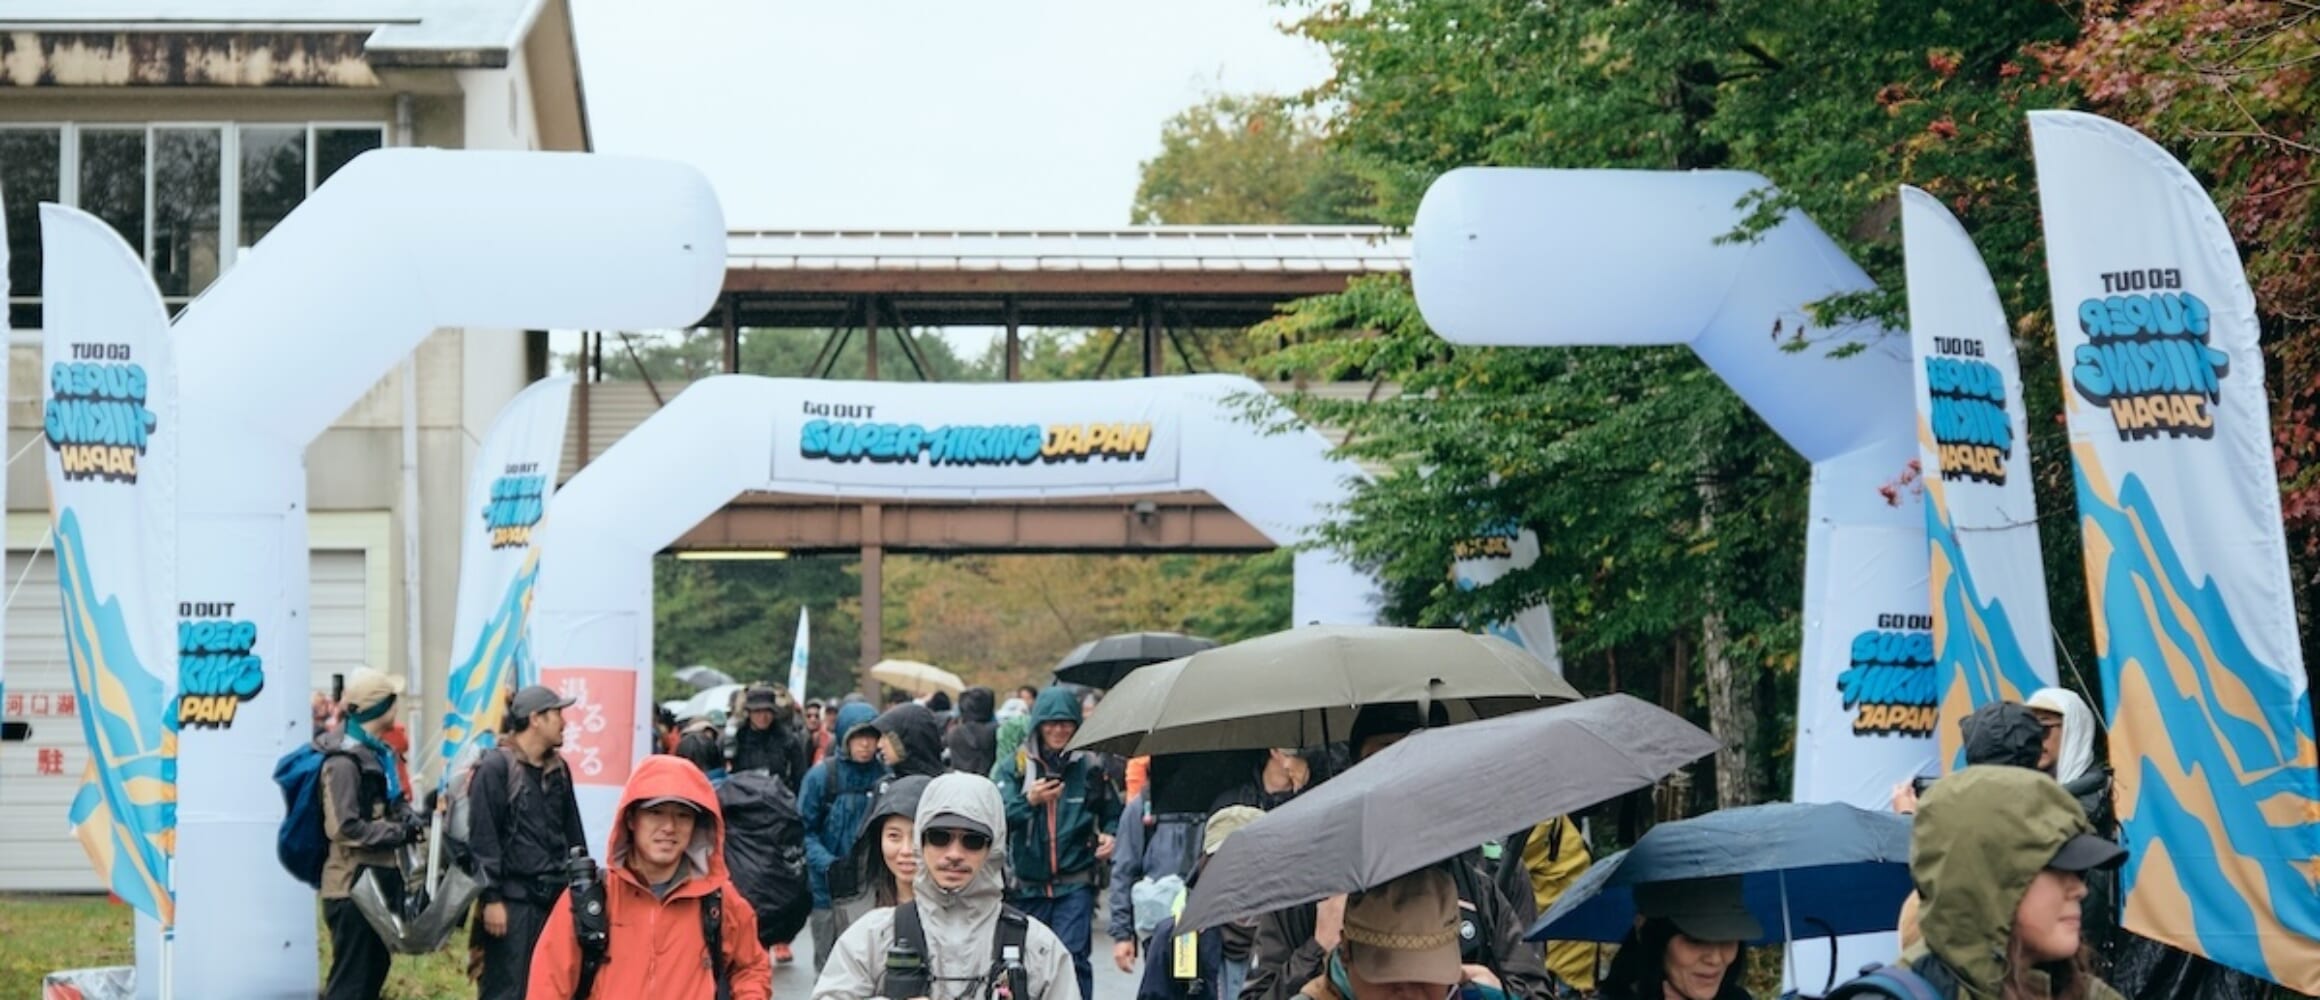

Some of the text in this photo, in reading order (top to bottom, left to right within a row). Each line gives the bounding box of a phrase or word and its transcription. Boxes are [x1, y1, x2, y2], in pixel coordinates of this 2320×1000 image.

[803, 401, 875, 419] GO OUT
[1041, 423, 1151, 464] JAPAN
[179, 602, 235, 617] O OUT
[1878, 614, 1933, 629] GO OU
[1850, 630, 1934, 667] SUPE
[178, 654, 265, 701] KING
[1837, 664, 1937, 711] HIKIN
[178, 695, 238, 729] PAN
[1852, 704, 1939, 738] JAPAN
